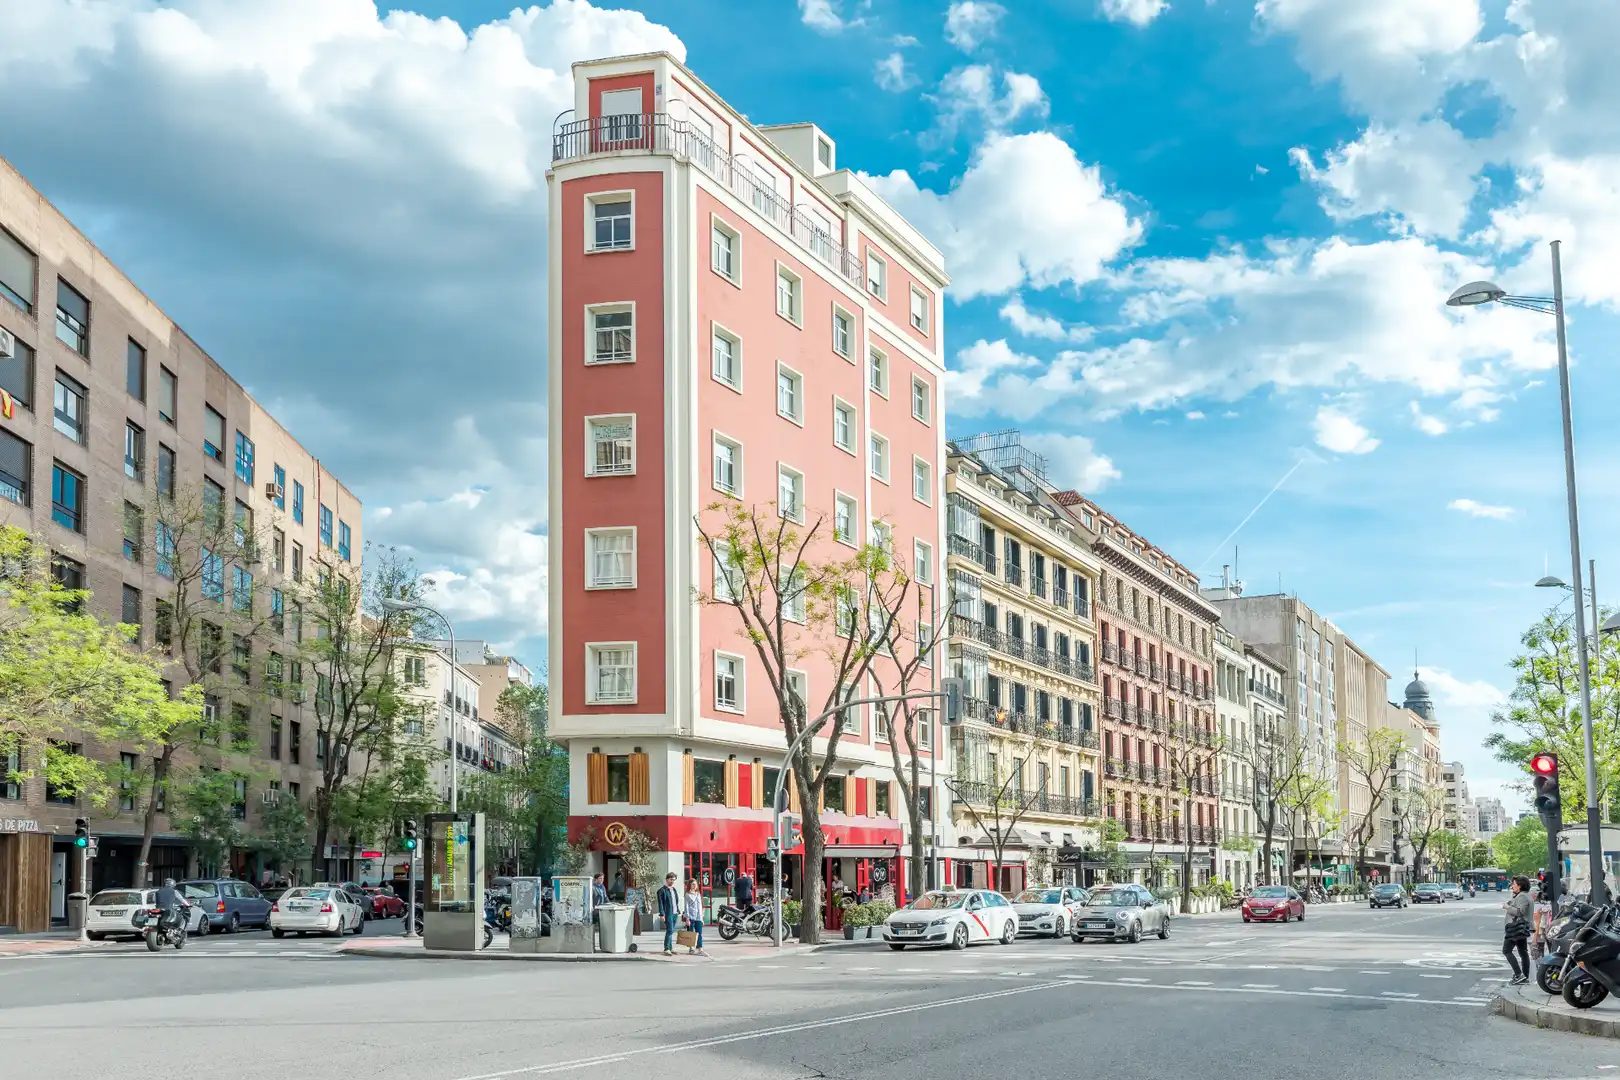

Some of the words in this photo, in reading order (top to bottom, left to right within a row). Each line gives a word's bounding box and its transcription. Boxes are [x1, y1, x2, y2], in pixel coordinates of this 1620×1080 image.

[4, 818, 16, 831] DE
[17, 819, 39, 832] PIZZA
[609, 828, 624, 841] W
